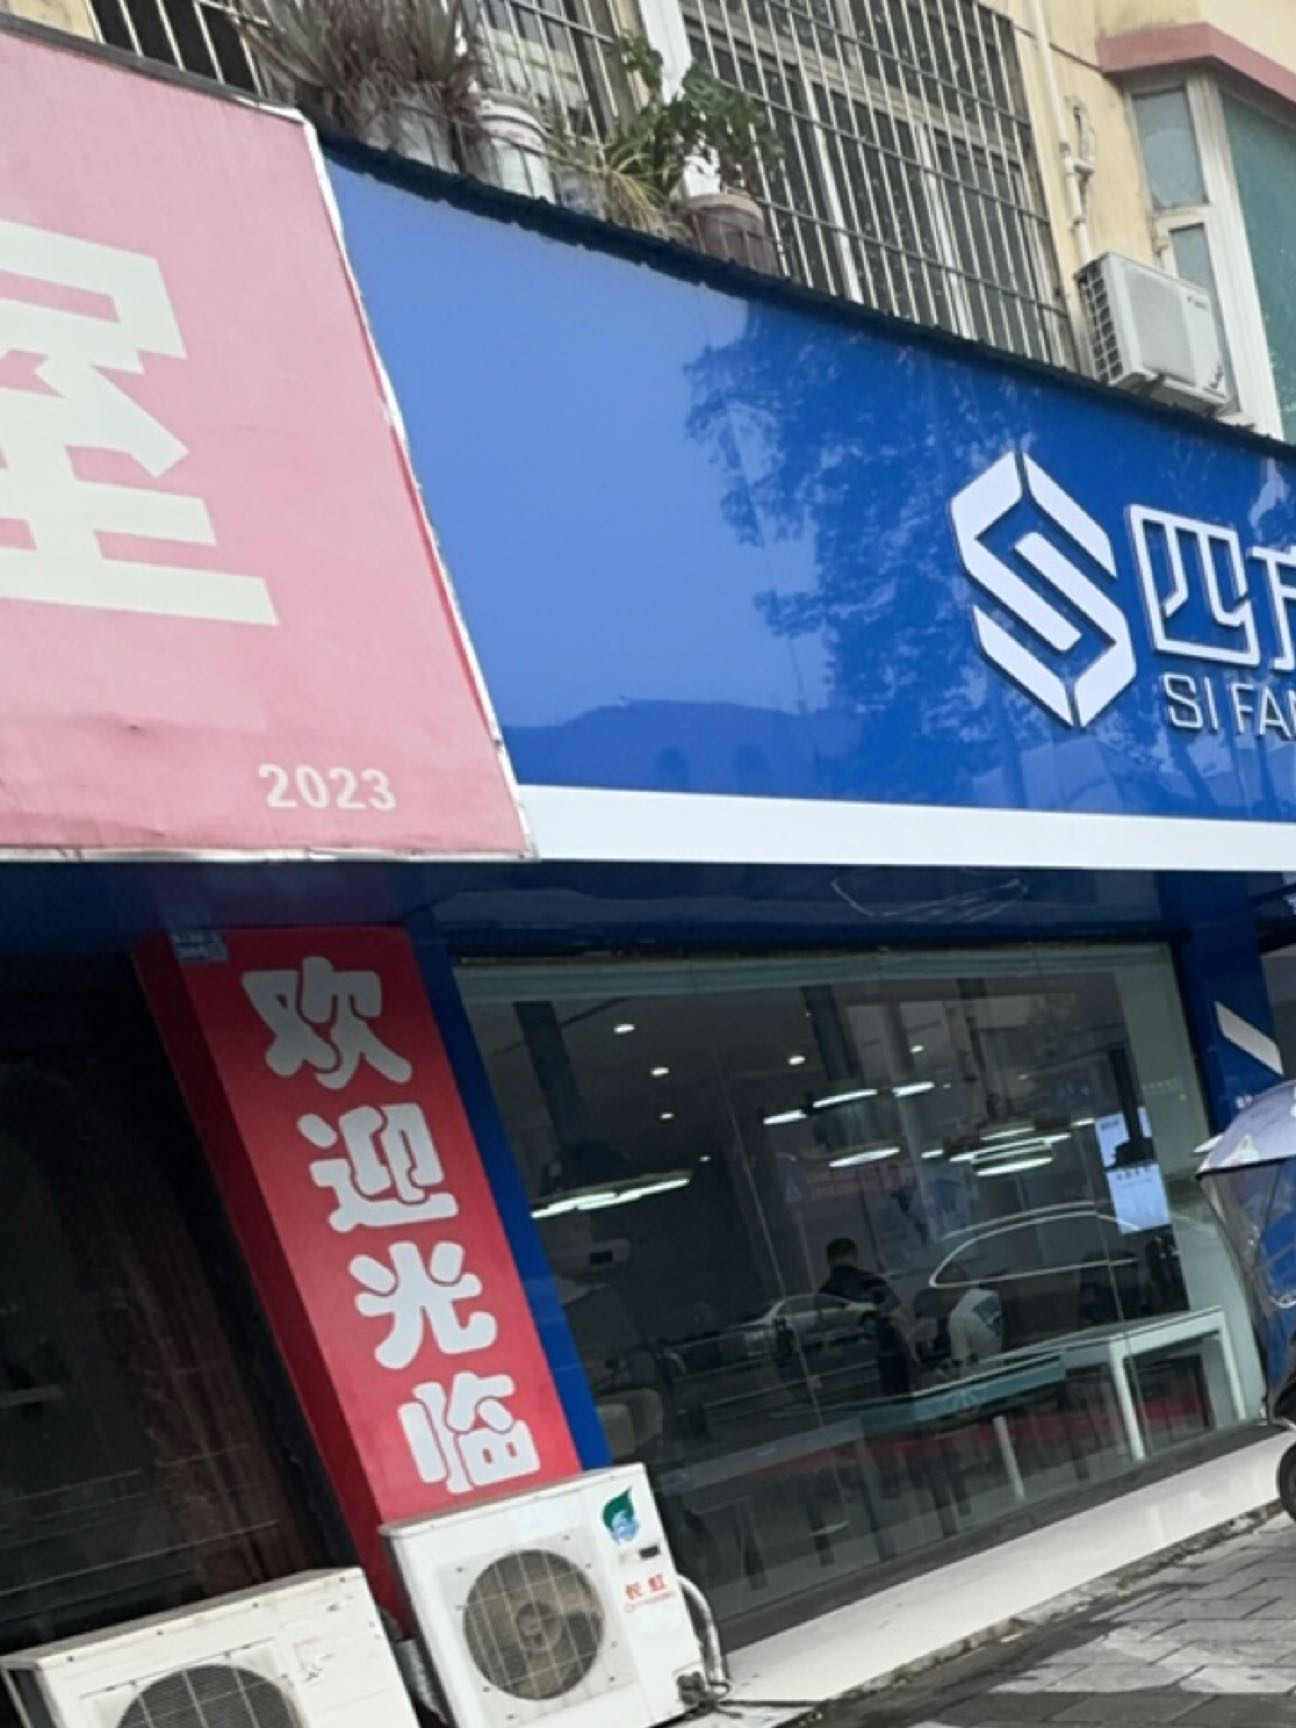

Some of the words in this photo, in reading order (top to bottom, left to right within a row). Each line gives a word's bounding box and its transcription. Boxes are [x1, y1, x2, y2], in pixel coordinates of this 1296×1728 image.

[1163, 673, 1220, 731] SI
[258, 763, 397, 810] 2023
[243, 956, 541, 1494] 欢迎光临
